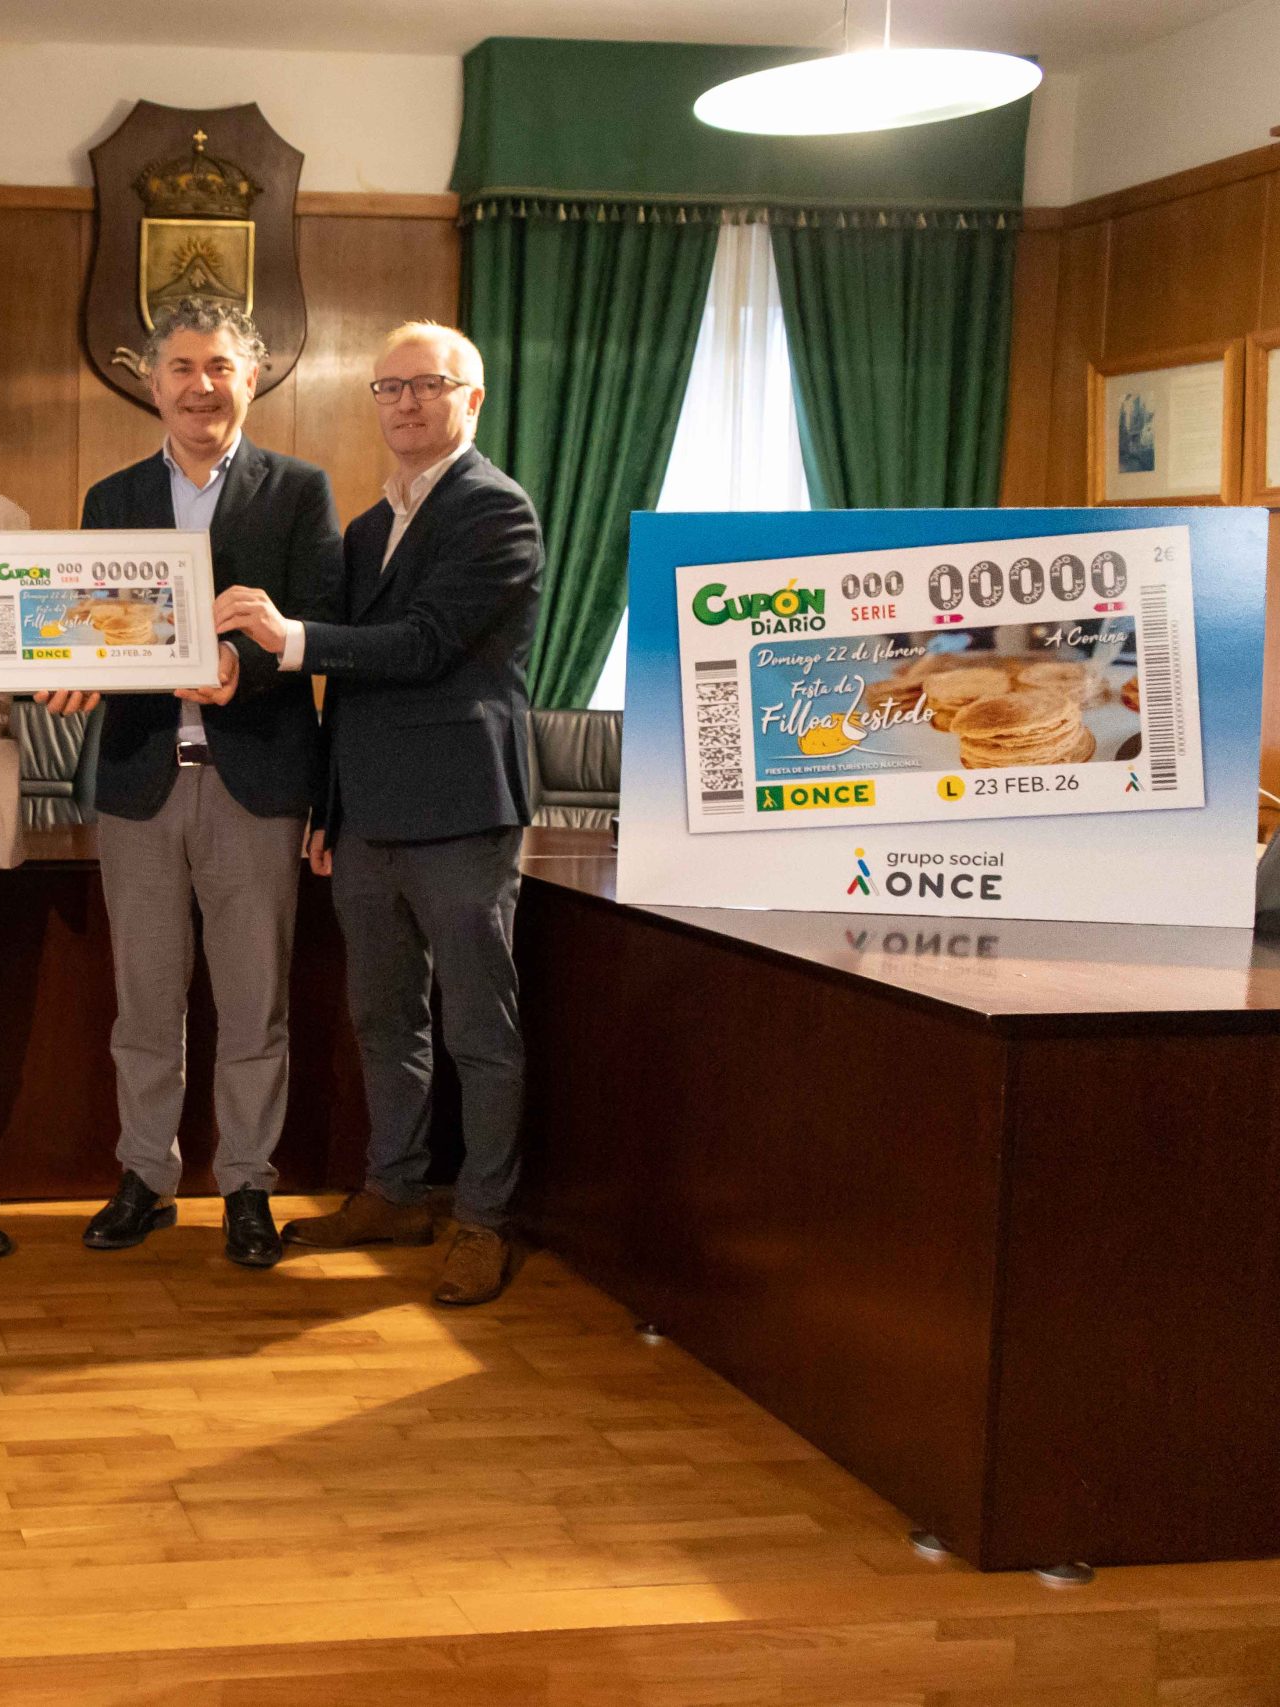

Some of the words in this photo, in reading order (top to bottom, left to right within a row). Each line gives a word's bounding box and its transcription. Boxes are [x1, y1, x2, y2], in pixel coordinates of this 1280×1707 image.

[1153, 546, 1175, 563] 2€
[56, 563, 82, 574] 000
[91, 561, 169, 581] 00000
[841, 570, 904, 600] 000
[928, 550, 1128, 611] 00000
[692, 578, 826, 626] CUPÓN
[851, 604, 896, 621] SERIE
[1044, 629, 1062, 647] A
[36, 649, 70, 659] ONCE
[757, 648, 821, 675] Domingo
[825, 646, 847, 662] 22
[851, 642, 869, 660] de
[873, 639, 927, 663] febrero
[791, 678, 832, 699] Festa
[834, 674, 855, 694] da
[759, 699, 838, 738] Filloa
[765, 766, 792, 775] FIESTA
[791, 766, 803, 774] DE
[946, 781, 958, 797] L
[974, 779, 998, 795] 23
[1004, 776, 1050, 794] FEB.
[1055, 774, 1079, 791] 26
[790, 784, 869, 806] ONCE
[886, 852, 945, 868] grupo
[949, 851, 1004, 867] social
[885, 871, 1002, 900] ONCE
